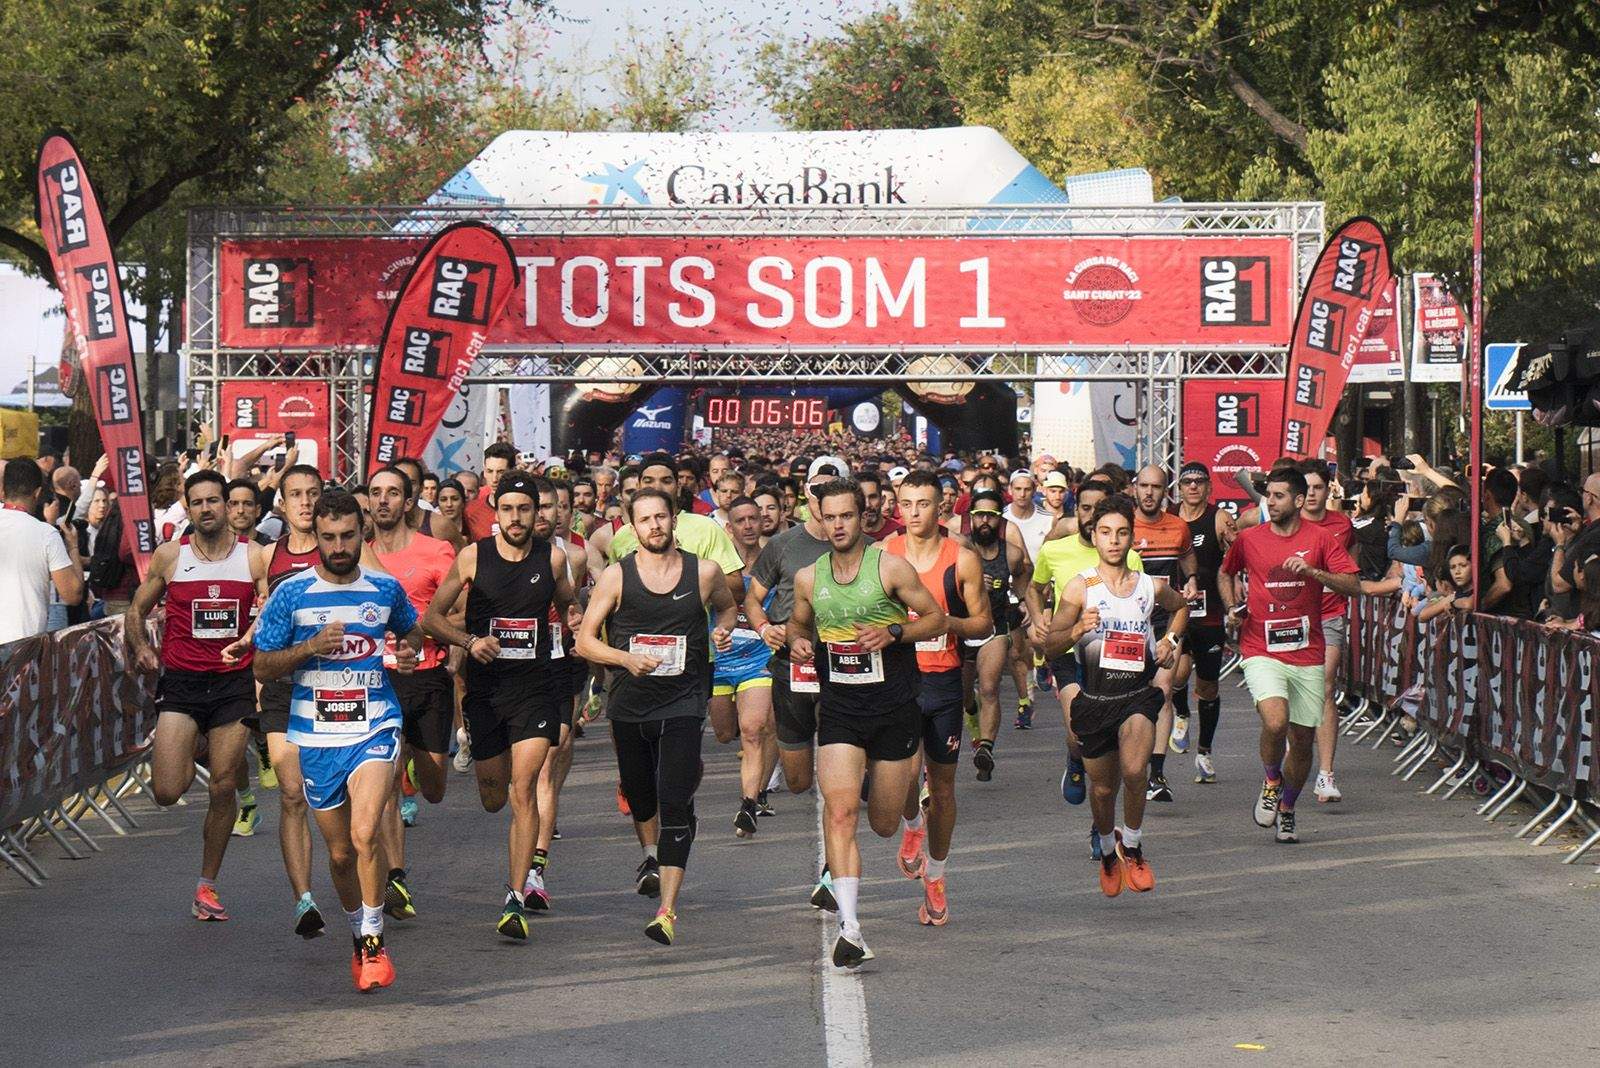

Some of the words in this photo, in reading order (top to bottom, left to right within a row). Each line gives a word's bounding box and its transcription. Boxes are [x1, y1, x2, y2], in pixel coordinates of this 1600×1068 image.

[666, 165, 906, 205] CaixaBank
[248, 262, 279, 324] RAC
[517, 256, 716, 329] TOTS
[746, 256, 926, 329] SOM
[958, 256, 1006, 328] 1
[1063, 289, 1091, 300] SANT
[1091, 289, 1125, 300] CUGAT
[1205, 260, 1236, 323] RAC
[708, 398, 740, 425] 00
[1218, 395, 1238, 434] RAC
[500, 631, 530, 640] XAVIER
[838, 656, 861, 665] ABEL
[1115, 645, 1138, 656] 1192
[325, 702, 357, 712] JOSEP
